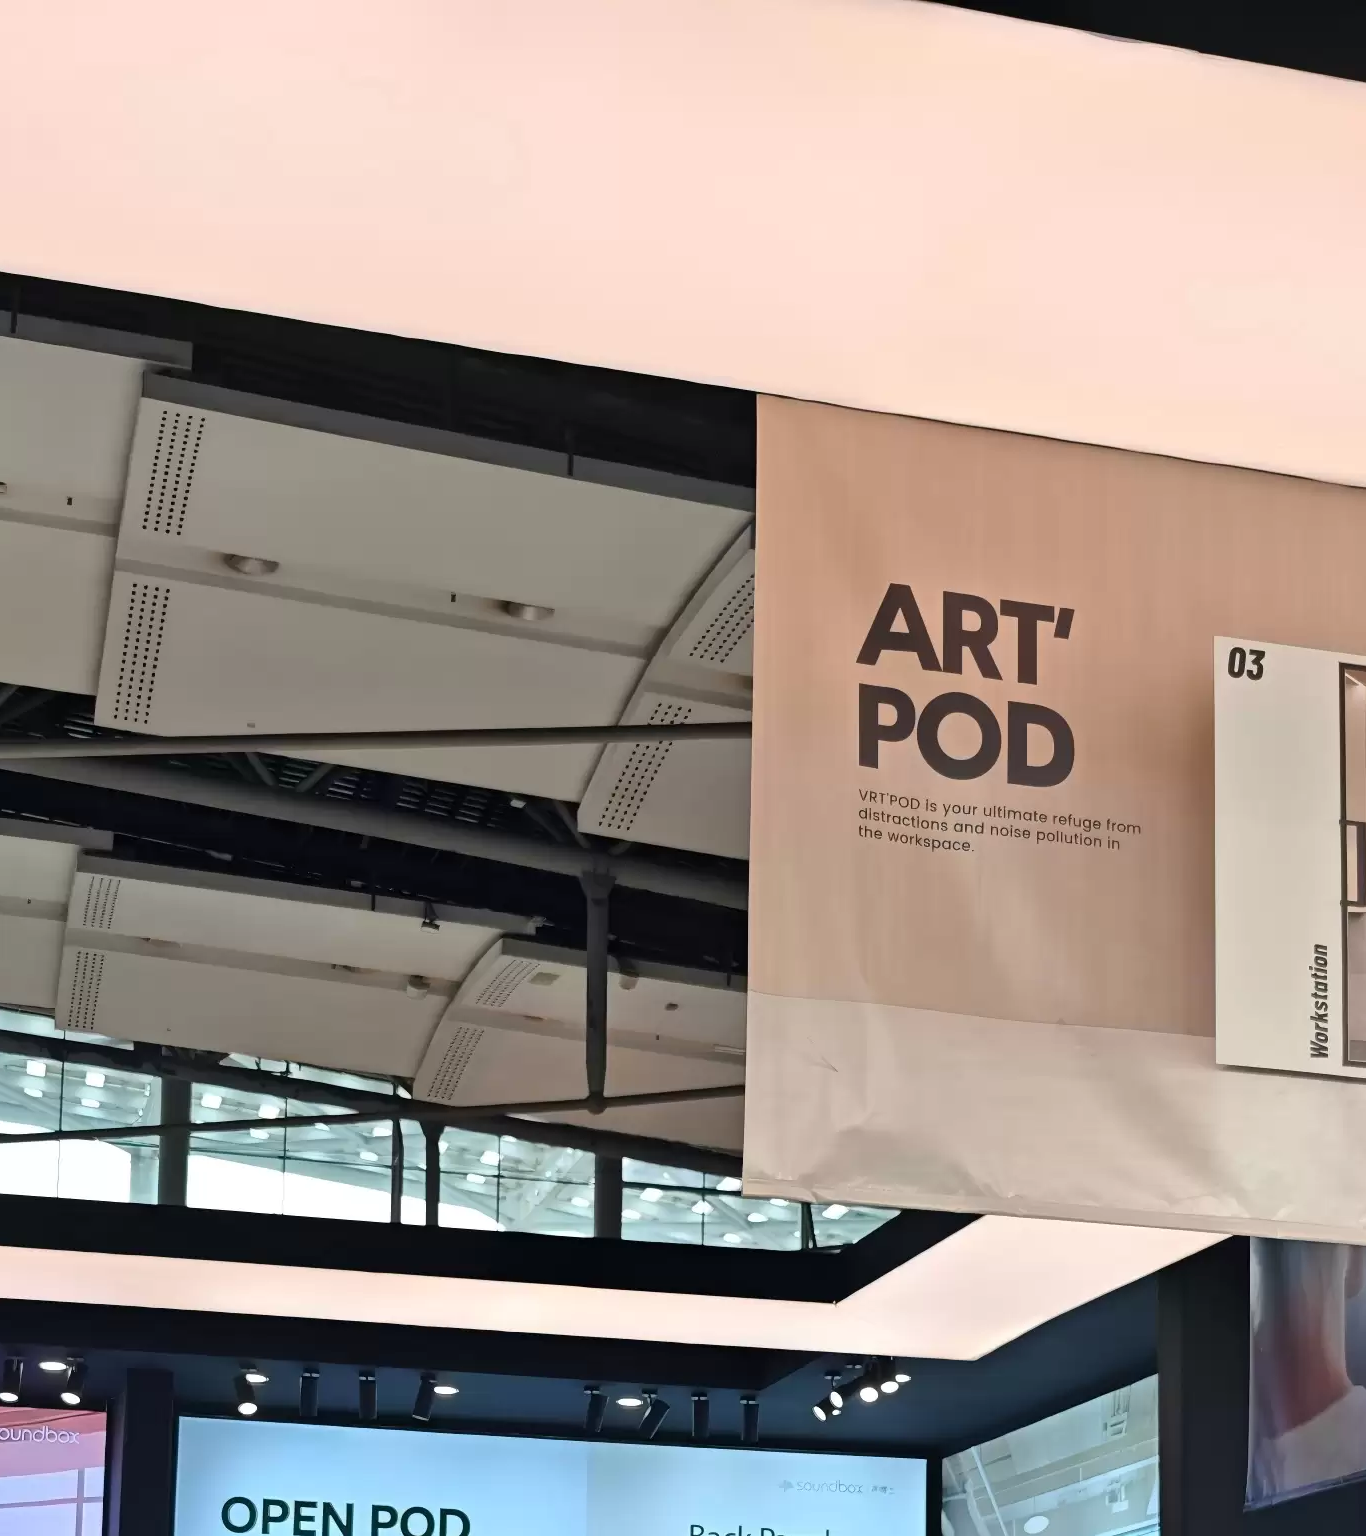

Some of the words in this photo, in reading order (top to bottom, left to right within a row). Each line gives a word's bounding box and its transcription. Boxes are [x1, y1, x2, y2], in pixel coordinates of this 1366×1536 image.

[855, 582, 1075, 686] ART'
[1227, 646, 1266, 681] 03
[858, 682, 1075, 787] POD
[858, 788, 921, 810] VRT'POD
[925, 799, 937, 812] is
[943, 803, 977, 817] your
[983, 804, 1048, 823] ultimate
[1053, 813, 1101, 832] refuge
[1106, 818, 1141, 834] from
[858, 807, 948, 832] distractions
[954, 822, 985, 835] and
[990, 825, 1031, 839] noise
[1036, 830, 1102, 848] pollution
[1107, 836, 1120, 850] in
[858, 825, 883, 839] the
[887, 831, 975, 852] workspace.
[1309, 943, 1329, 1060] Workstation
[796, 1479, 863, 1494] soundbox
